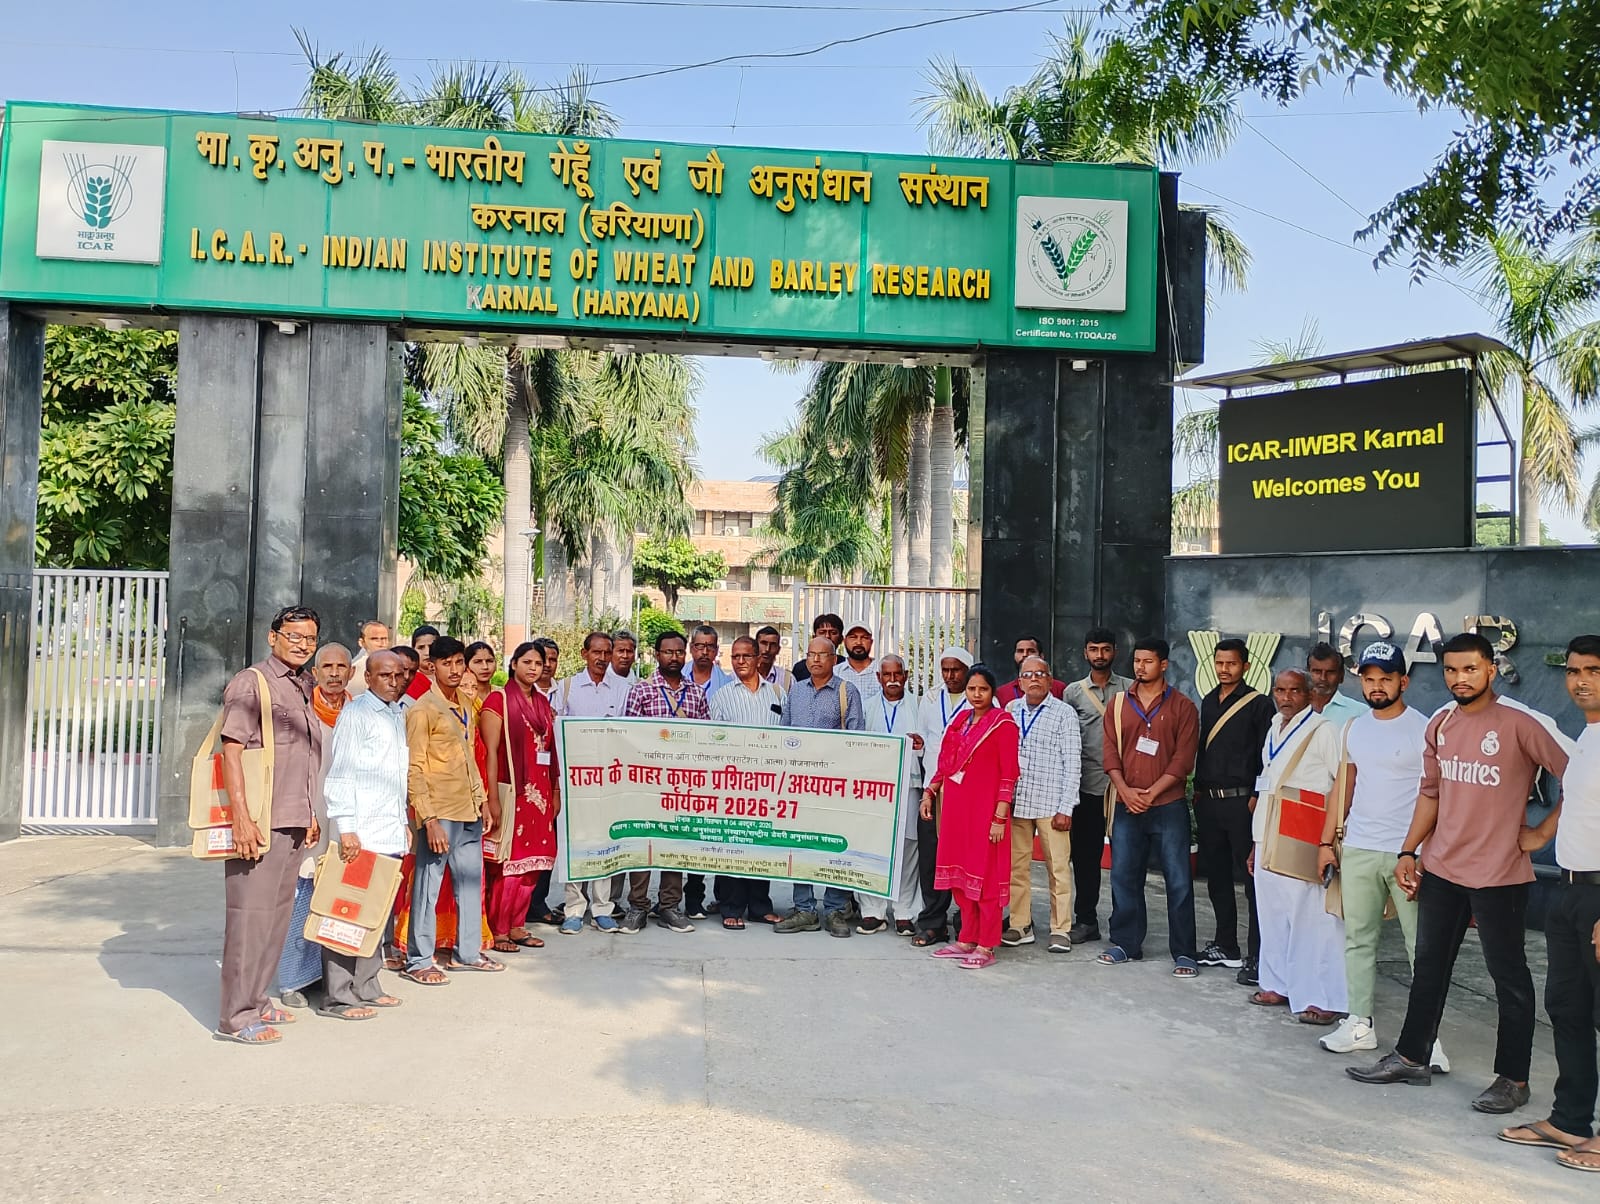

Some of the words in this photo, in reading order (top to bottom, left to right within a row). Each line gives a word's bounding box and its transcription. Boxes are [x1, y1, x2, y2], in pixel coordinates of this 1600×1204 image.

[425, 135, 526, 183] भारतीय
[549, 139, 595, 198] गेहूँ
[622, 148, 662, 196] एवं
[687, 149, 725, 195] जौ
[749, 156, 873, 212] अनुसंधान
[899, 164, 990, 208] संस्थान
[471, 204, 567, 234] करनाल
[578, 201, 704, 249] (हरियाणा)
[77, 241, 115, 251] ICAR
[322, 235, 408, 270] INDIAN
[422, 240, 551, 278] INSTITUTE
[569, 249, 598, 280] OF
[613, 250, 696, 285] WHEAT
[709, 256, 755, 288] AND
[770, 259, 858, 293] BARLEY
[872, 263, 991, 299] RESEARCH
[465, 283, 558, 313] KARNAL
[572, 286, 700, 323] (HARYANA)
[1015, 329, 1058, 338] Certificate
[1059, 331, 1073, 339] No.
[1038, 317, 1054, 326] ISO
[1227, 433, 1357, 463] ICAR-IIWBR
[1363, 422, 1445, 450] Karnal
[1252, 473, 1367, 499] Welcomes
[1372, 468, 1421, 491] You
[568, 766, 604, 786] राज्य
[607, 758, 623, 785] के
[627, 764, 663, 785] बाहर
[666, 768, 707, 793] कृषक
[852, 778, 896, 803] भ्रमण
[1436, 754, 1501, 787] mirates
[724, 796, 799, 820] 2026-27
